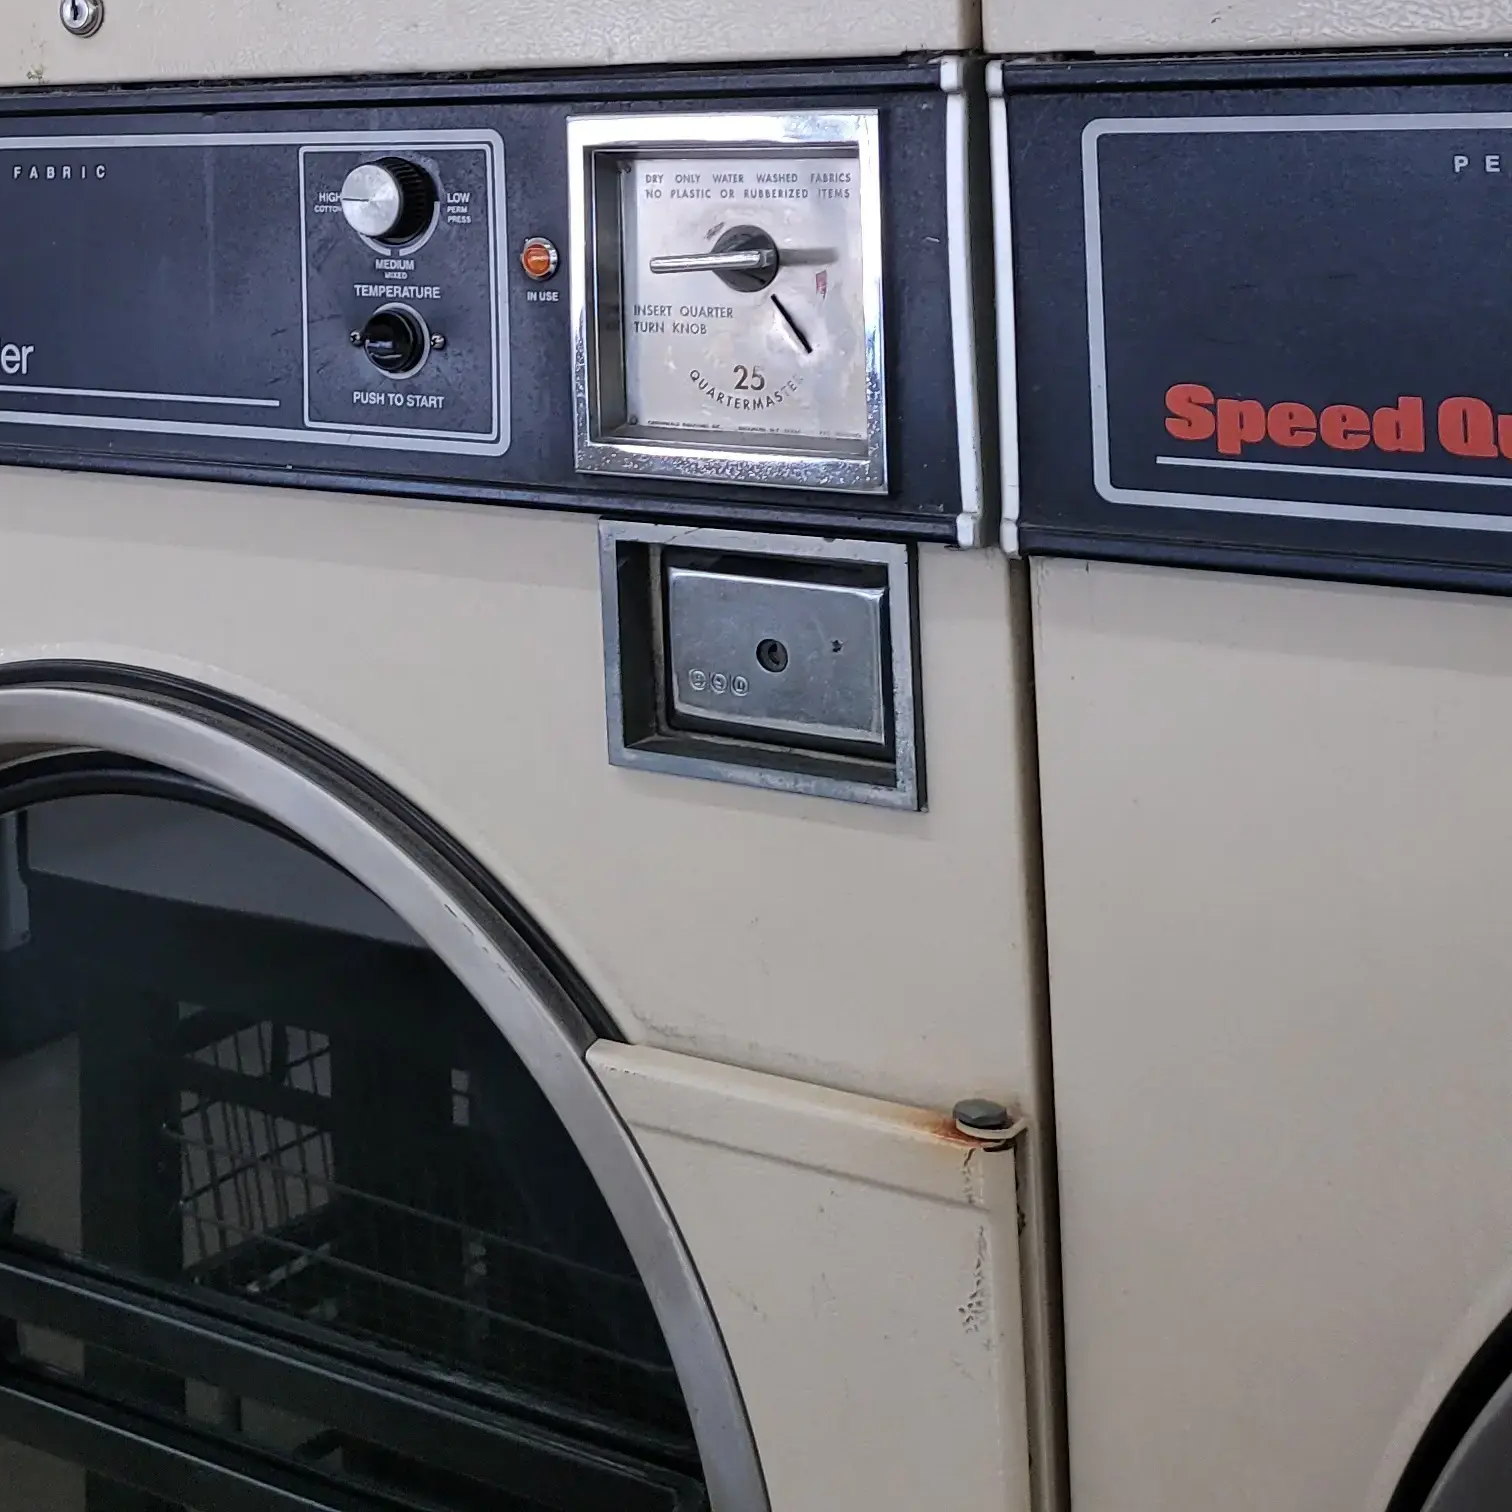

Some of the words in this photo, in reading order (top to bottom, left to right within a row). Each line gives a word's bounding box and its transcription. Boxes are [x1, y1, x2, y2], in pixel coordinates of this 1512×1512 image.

[13, 165, 107, 179] FABRIC
[645, 174, 664, 184] DRY
[675, 174, 701, 184] ONLY
[713, 173, 744, 183] WATER
[756, 173, 798, 183] WASHED
[810, 172, 851, 183] FABRICS
[447, 192, 470, 203] LOW
[646, 189, 662, 199] NO
[670, 189, 711, 199] PLASTIC
[720, 188, 735, 199] OR
[744, 188, 808, 199] RUBBERIZED
[818, 188, 850, 198] ITEMS
[447, 205, 468, 213] PERM
[447, 215, 471, 224] PRESS
[375, 259, 414, 270] MEDIUM
[384, 272, 408, 280] MIXED
[354, 284, 441, 299] TEMPERATURE
[527, 291, 538, 302] IN
[539, 291, 559, 302] USE
[634, 305, 672, 317] INSERT
[679, 305, 734, 319] QUARTER
[634, 320, 665, 333] TURN
[672, 322, 708, 335] KNOB
[732, 364, 766, 391] 25
[353, 391, 385, 405] PUSH
[387, 393, 404, 406] TO
[406, 394, 445, 408] START
[1164, 383, 1426, 456] Speed
